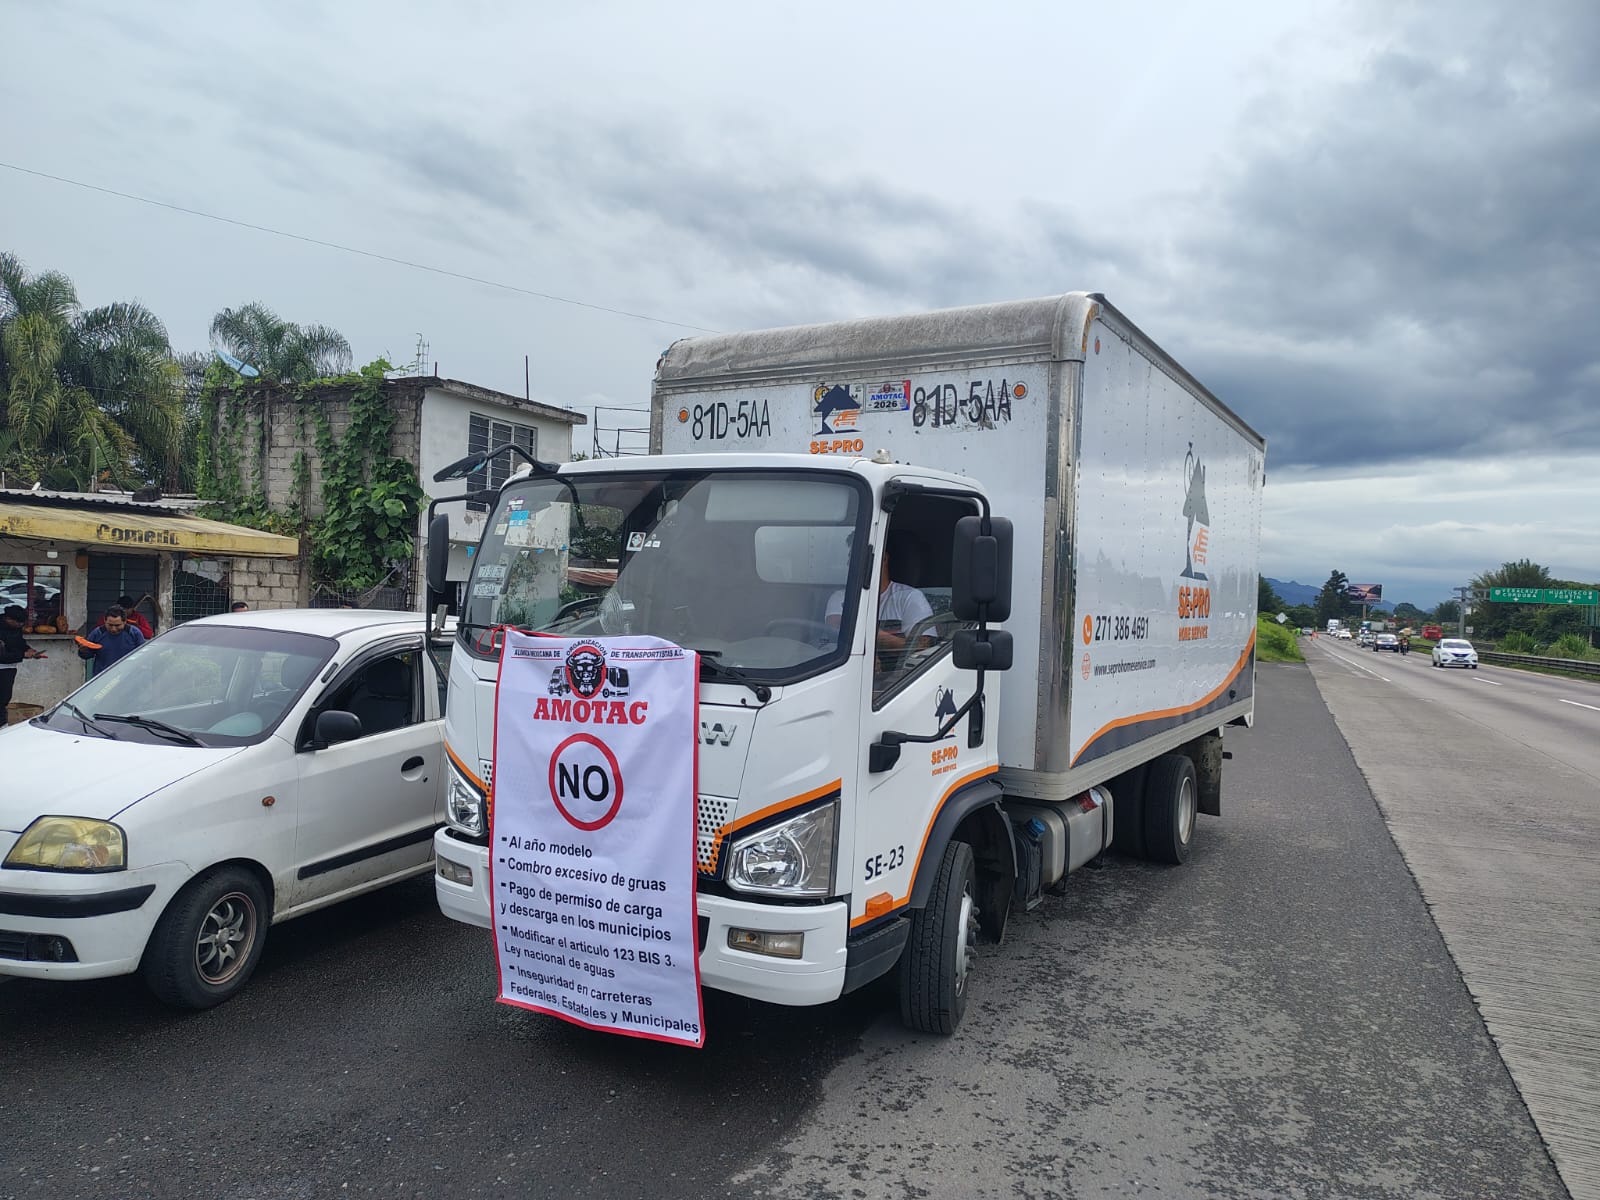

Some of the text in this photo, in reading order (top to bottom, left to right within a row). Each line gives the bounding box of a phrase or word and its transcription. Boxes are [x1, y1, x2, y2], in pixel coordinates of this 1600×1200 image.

[692, 400, 771, 440] 81D-5AA
[874, 400, 898, 409] 2026
[913, 379, 1011, 427] 81D-5AA
[810, 438, 864, 454] SE-PRO
[1178, 586, 1210, 619] SE-PRO
[1095, 616, 1149, 640] 271 386 4691
[554, 650, 560, 658] DE
[610, 650, 620, 658] DE
[534, 698, 648, 725] AMOTAC
[931, 745, 958, 765] SE-PRO
[558, 763, 610, 802] NO
[509, 836, 592, 858] Al año modelo
[864, 845, 904, 880] SE-23
[508, 857, 666, 892] Combro excesivo de gruas
[510, 881, 662, 920] Pago de permiso de carga
[500, 902, 672, 942] y descarga en los municipios
[504, 942, 615, 978] Ley nacional de aguas
[510, 925, 676, 968] Modificar el articulo 123 BIS 3.
[518, 966, 652, 1006] Inseguridad en carreteras
[510, 982, 699, 1034] Federales, Estatales y Municipales
